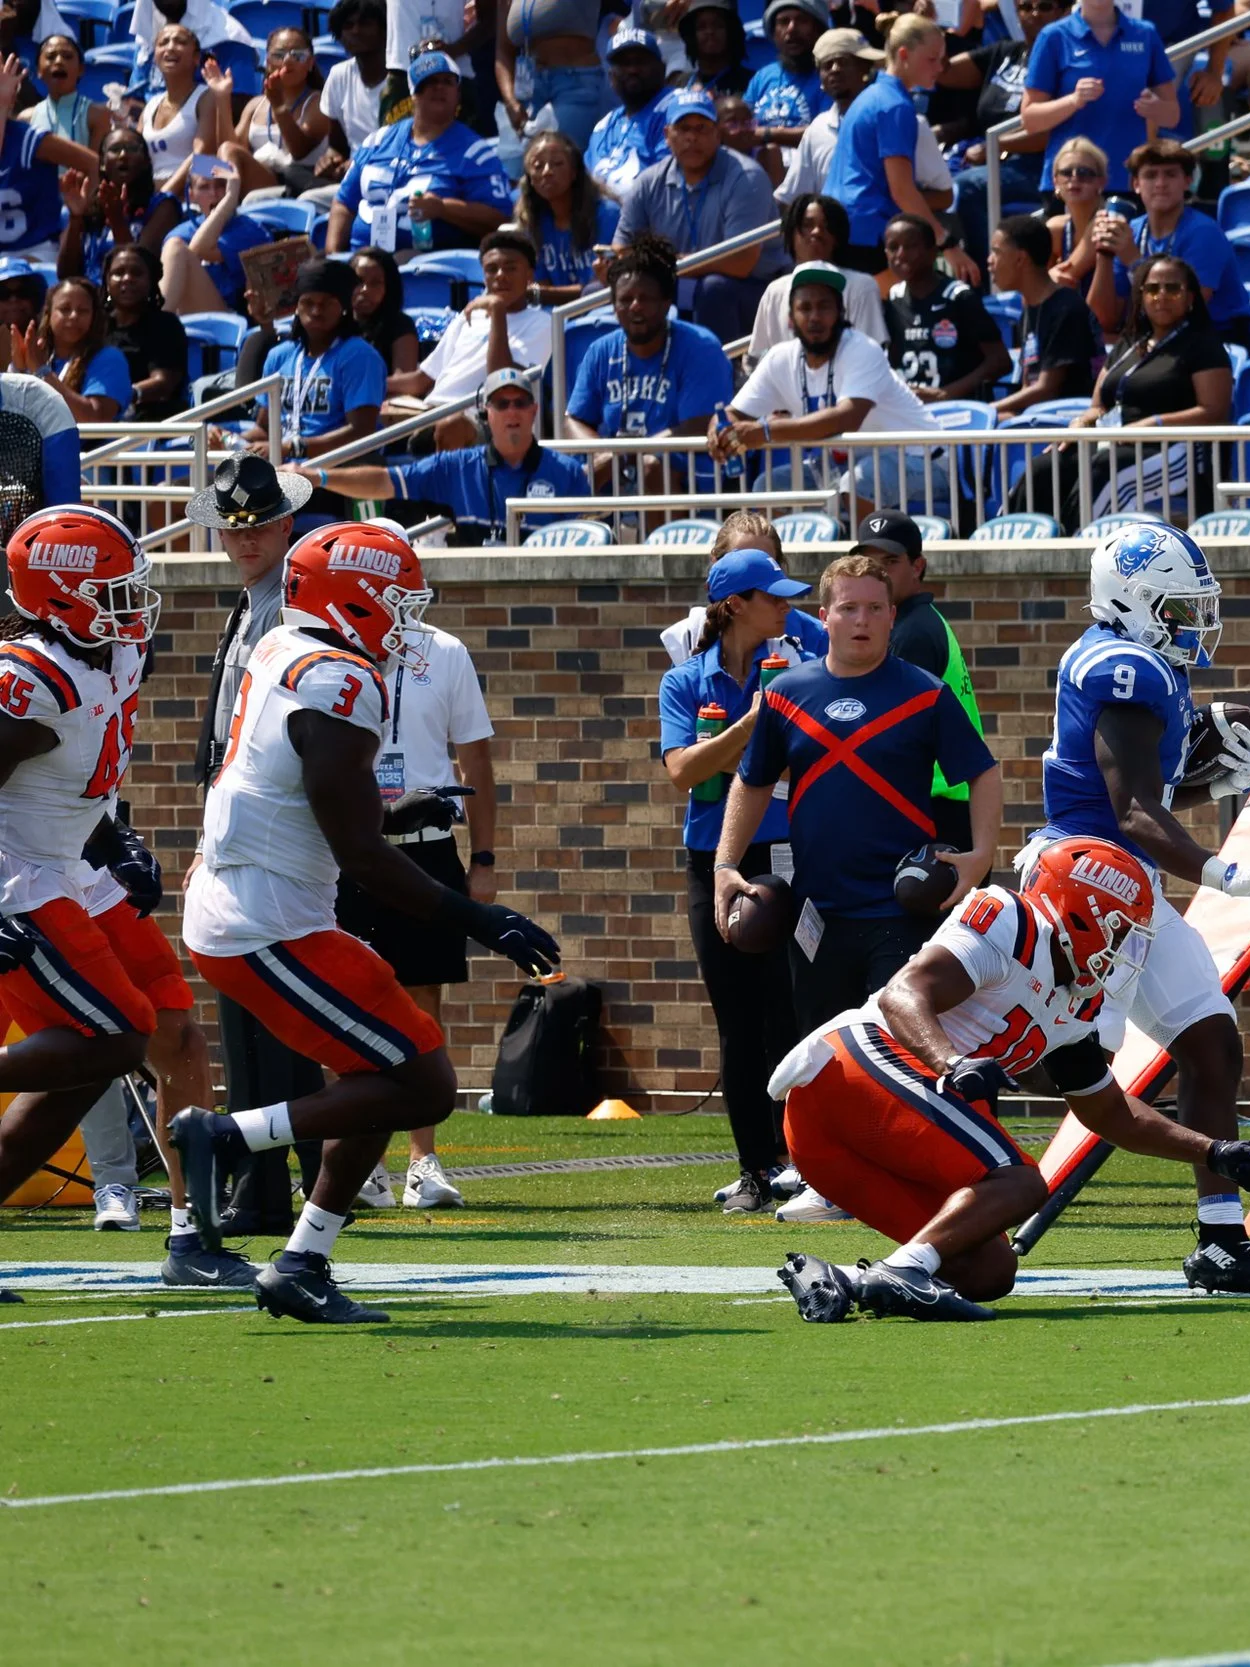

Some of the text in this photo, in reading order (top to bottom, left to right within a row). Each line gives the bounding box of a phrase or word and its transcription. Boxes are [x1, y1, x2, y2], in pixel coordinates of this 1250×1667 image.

[611, 28, 646, 49] DUKE
[279, 375, 332, 415] UKE
[606, 374, 673, 404] DUKE
[777, 520, 831, 542] UKE
[29, 542, 98, 569] ILLINOIS
[328, 543, 402, 576] ILLINOIS
[1199, 577, 1214, 588] DUKE
[331, 673, 363, 717] 3
[1112, 663, 1136, 700] 9
[838, 704, 860, 713] ACC
[376, 772, 402, 784] 025
[1071, 856, 1141, 903] ILLINOIS
[960, 890, 1005, 935] 10
[963, 1003, 1048, 1077] 10
[1201, 1242, 1237, 1270] NIKE
